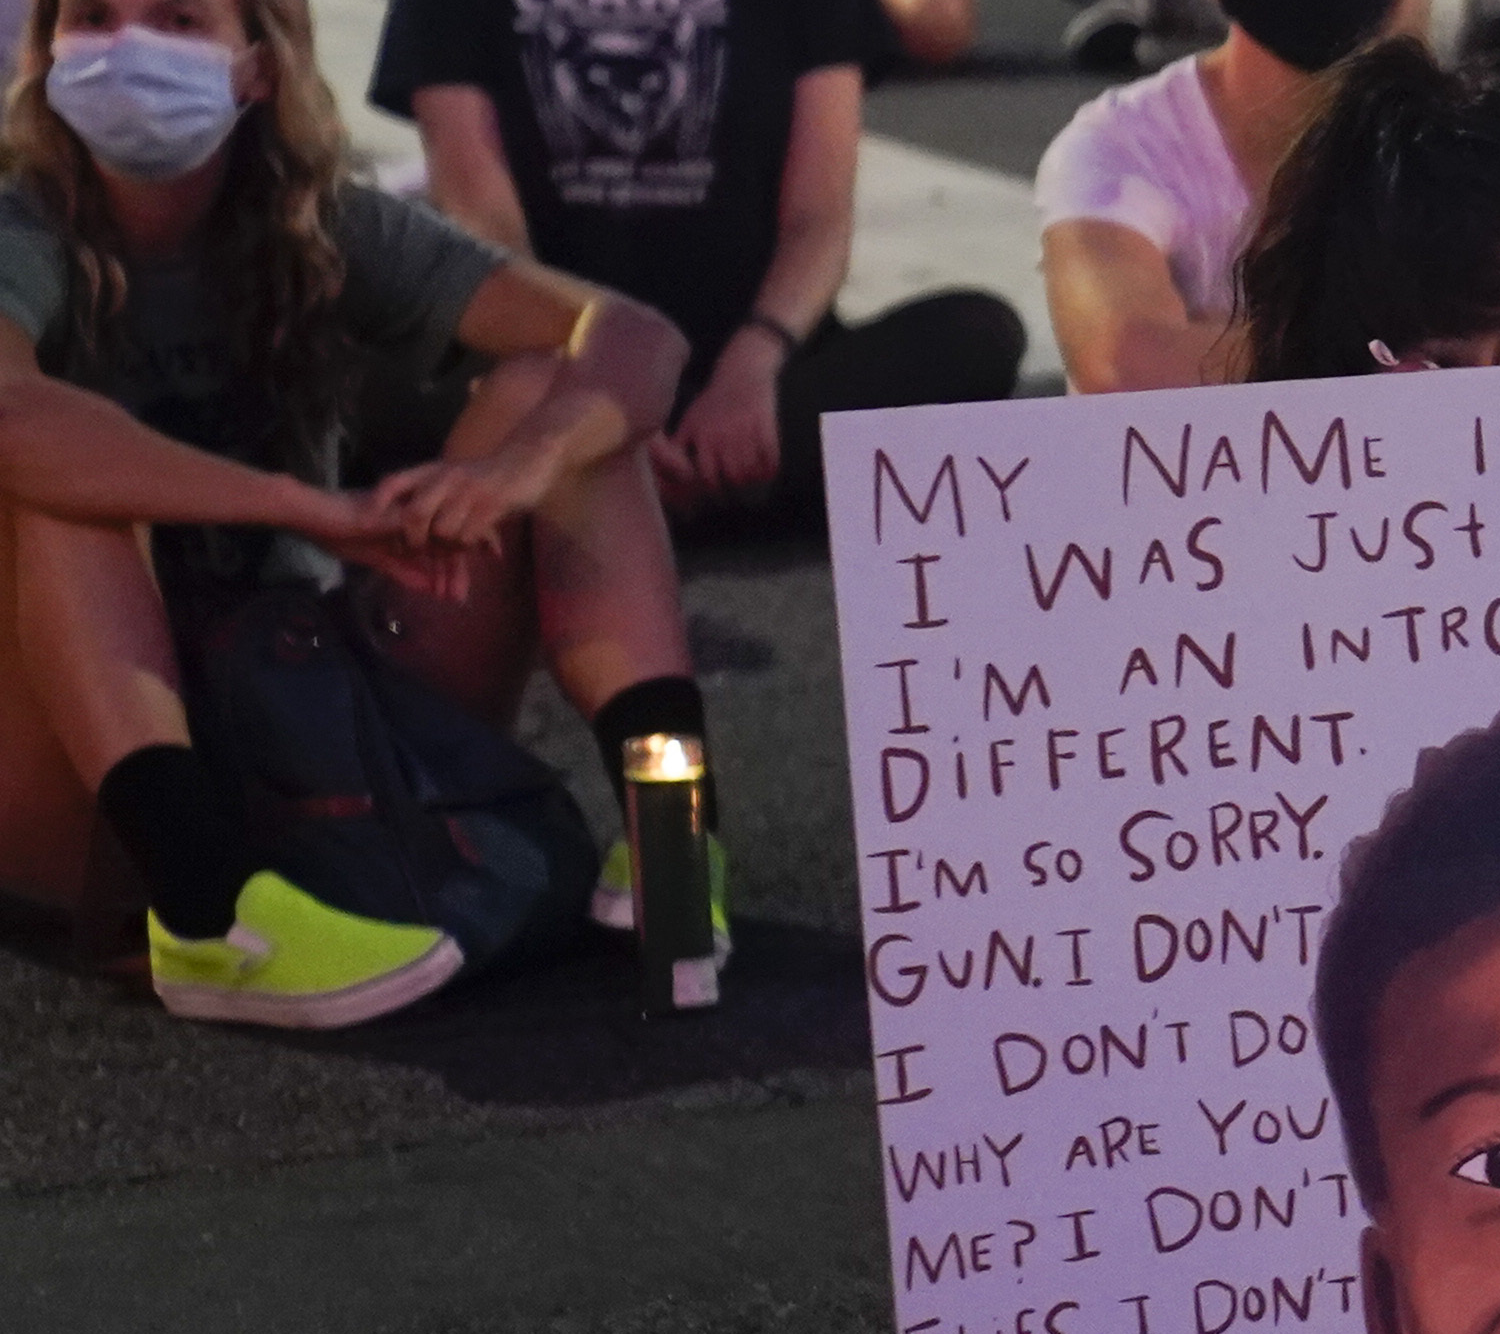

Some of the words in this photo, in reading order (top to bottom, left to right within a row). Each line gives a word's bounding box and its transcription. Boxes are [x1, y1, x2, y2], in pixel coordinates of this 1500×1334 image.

[873, 448, 1030, 544] MY
[1122, 410, 1386, 506] NAME
[897, 554, 949, 629] I
[1024, 517, 1224, 612] WAS
[875, 658, 1051, 735] I'M
[1119, 632, 1236, 695] AN
[867, 849, 988, 914] I'M
[1023, 841, 1083, 887] SO
[1056, 928, 1093, 987] I
[1133, 905, 1323, 984] DON'T
[875, 1044, 933, 1105] I
[993, 1010, 1190, 1097] DON'T
[1229, 1010, 1308, 1069] DO
[888, 1133, 1023, 1203] WHY
[1065, 1116, 1161, 1171] ARE
[1197, 1098, 1329, 1156] YOU
[1058, 1210, 1101, 1262] I
[1144, 1169, 1348, 1254] DON'T
